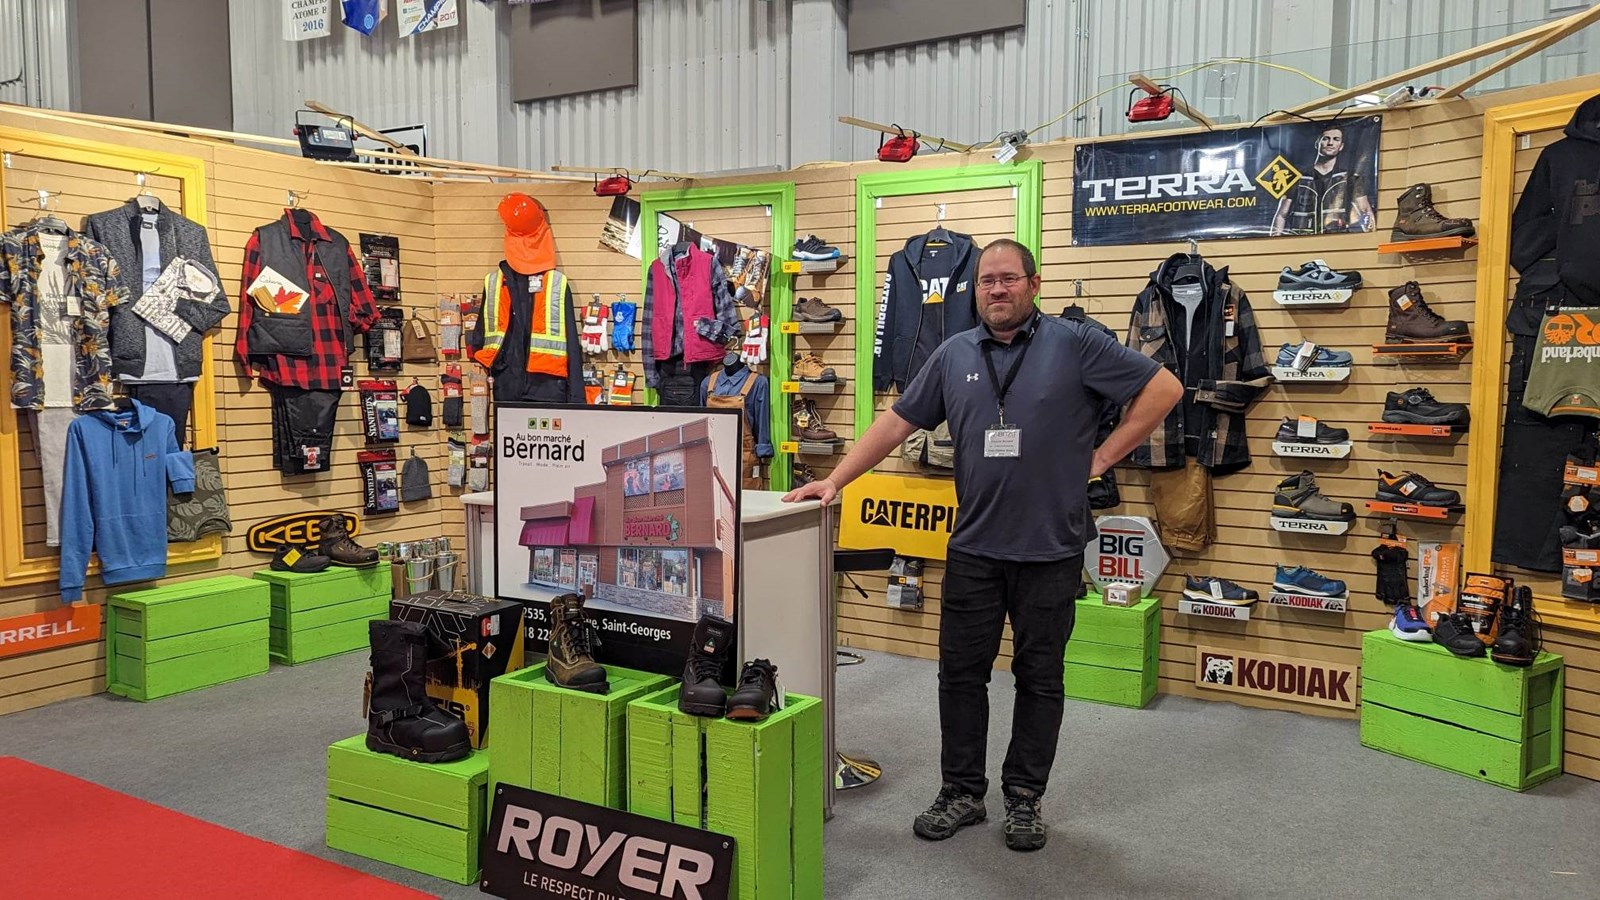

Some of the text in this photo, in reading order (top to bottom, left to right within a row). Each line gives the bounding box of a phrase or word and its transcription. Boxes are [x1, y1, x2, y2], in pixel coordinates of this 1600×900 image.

[292, 8, 319, 20] ATOME
[302, 19, 324, 32] 2016
[440, 11, 456, 22] 2017
[920, 276, 950, 303] CAT
[366, 396, 377, 437] STANFIELD'S
[503, 436, 585, 462] Bernard
[516, 433, 571, 443] Au bon marché
[366, 468, 376, 509] STANFIELD'S
[259, 519, 353, 544] KEE
[625, 522, 671, 537] BERNARD
[1099, 534, 1144, 557] BIG
[1099, 555, 1144, 579] BILL
[1202, 605, 1236, 618] KODIAK
[1288, 595, 1323, 609] KODIAK
[602, 618, 672, 642] Saint-Georges
[1237, 657, 1351, 703] KODIAK
[496, 804, 715, 900] ROYER
[523, 871, 539, 888] LE
[540, 876, 595, 900] RESPECT
